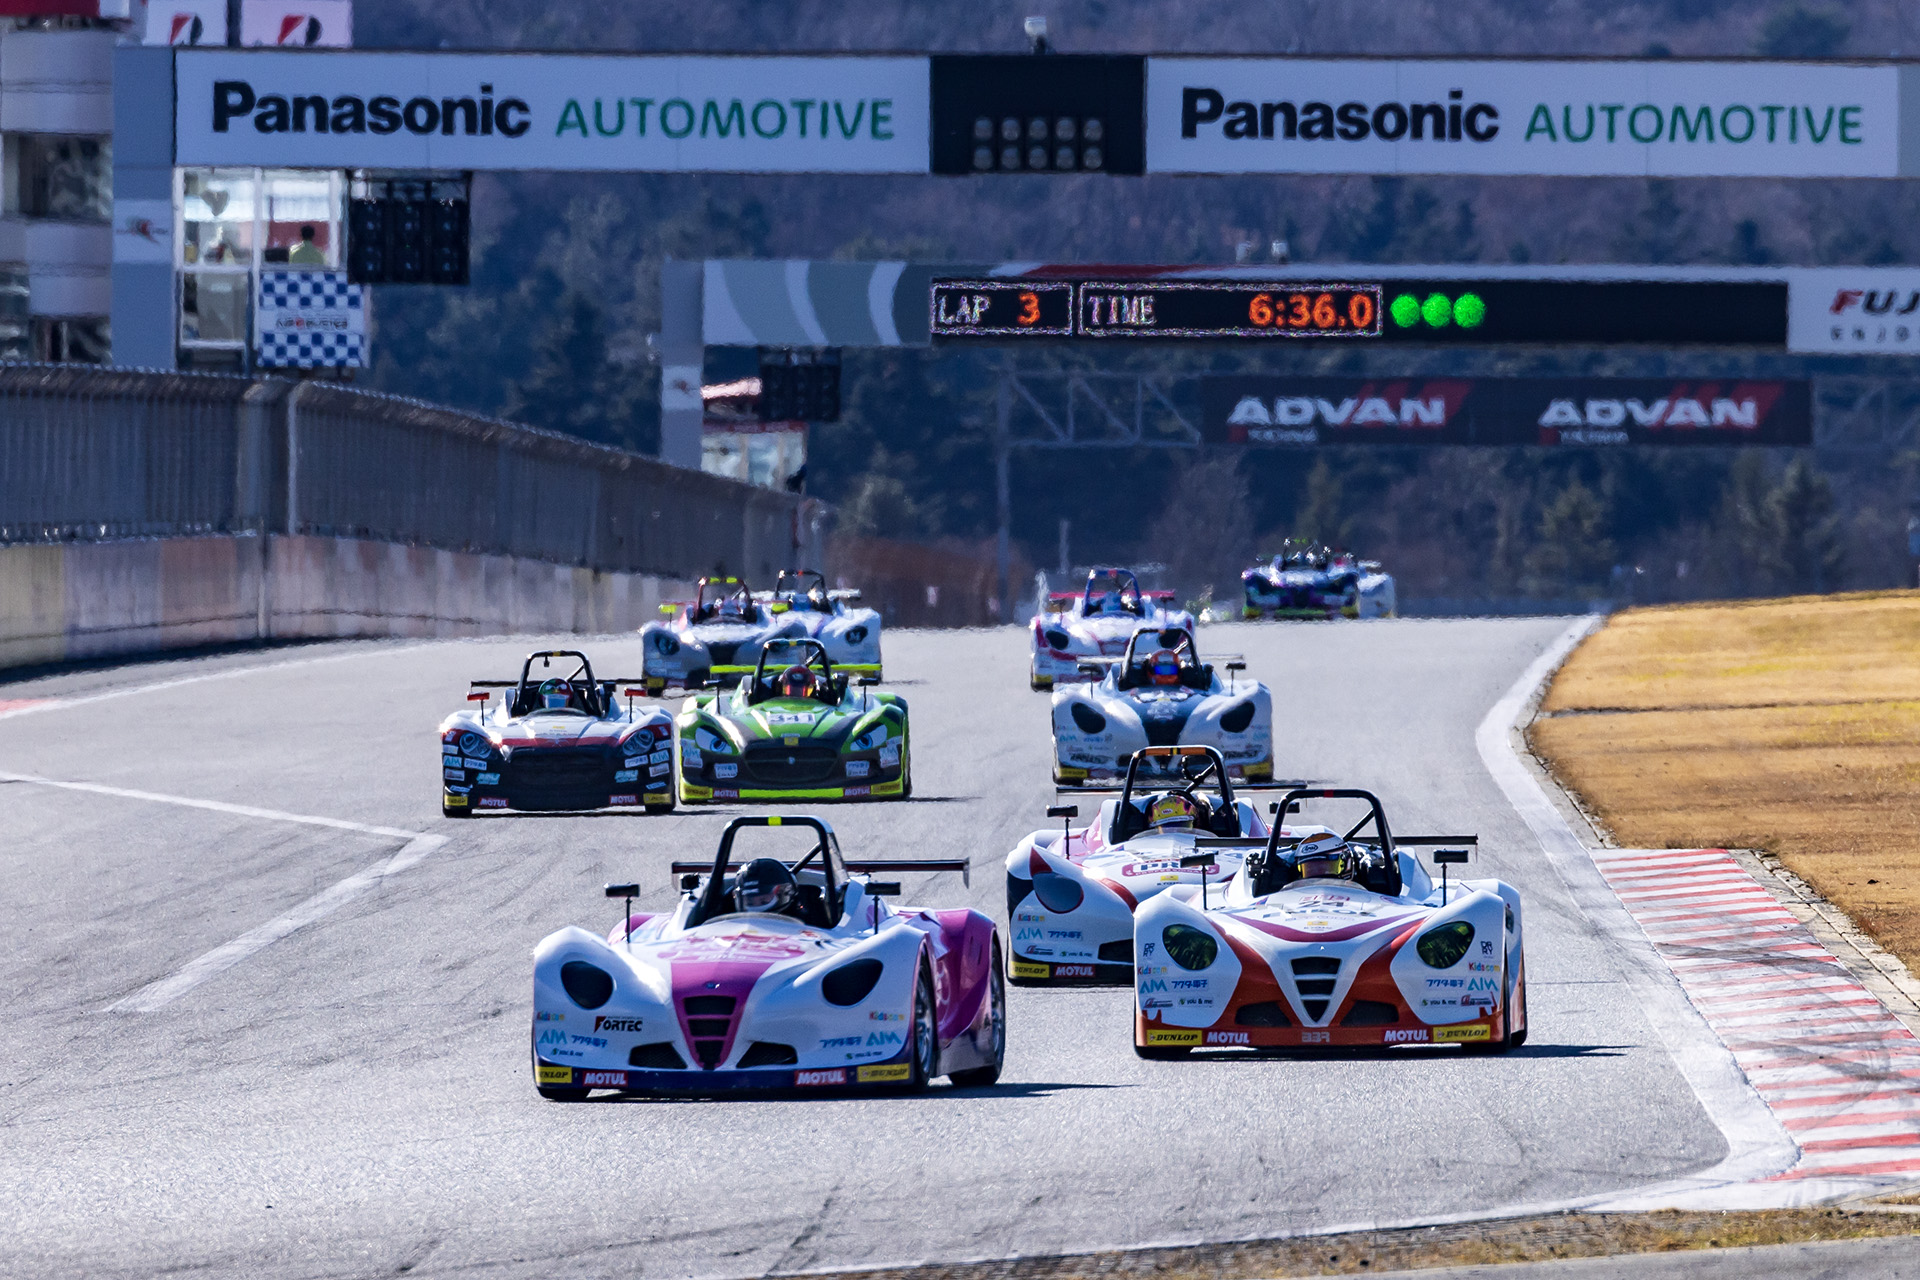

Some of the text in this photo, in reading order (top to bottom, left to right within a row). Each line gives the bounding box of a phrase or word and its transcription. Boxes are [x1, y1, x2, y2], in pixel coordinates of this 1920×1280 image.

[213, 81, 894, 140] Panasonic AUTOMOTIVE
[1182, 88, 1864, 145] Panasonic AUTOMOTIVE
[938, 292, 1041, 325] LAP 3
[1087, 293, 1374, 328] TIME 6:36.0
[1227, 396, 1446, 426] ADVAN
[1538, 397, 1758, 427] ADVAN
[480, 797, 507, 807] MOTUL
[611, 795, 636, 804] MOTUL
[1015, 966, 1046, 974] DUNLOP
[1056, 966, 1094, 976] MOTUL
[1140, 979, 1168, 994] AIM
[1467, 977, 1499, 992] AIM
[594, 1016, 643, 1033] FORTEC
[1156, 1033, 1198, 1041] DUNLOP
[1206, 1031, 1250, 1044] MOTUL
[1384, 1029, 1429, 1042] MOTUL
[1446, 1029, 1488, 1038] DUNLOP
[584, 1072, 627, 1085] MOTUL
[797, 1070, 845, 1085] MOTUL
